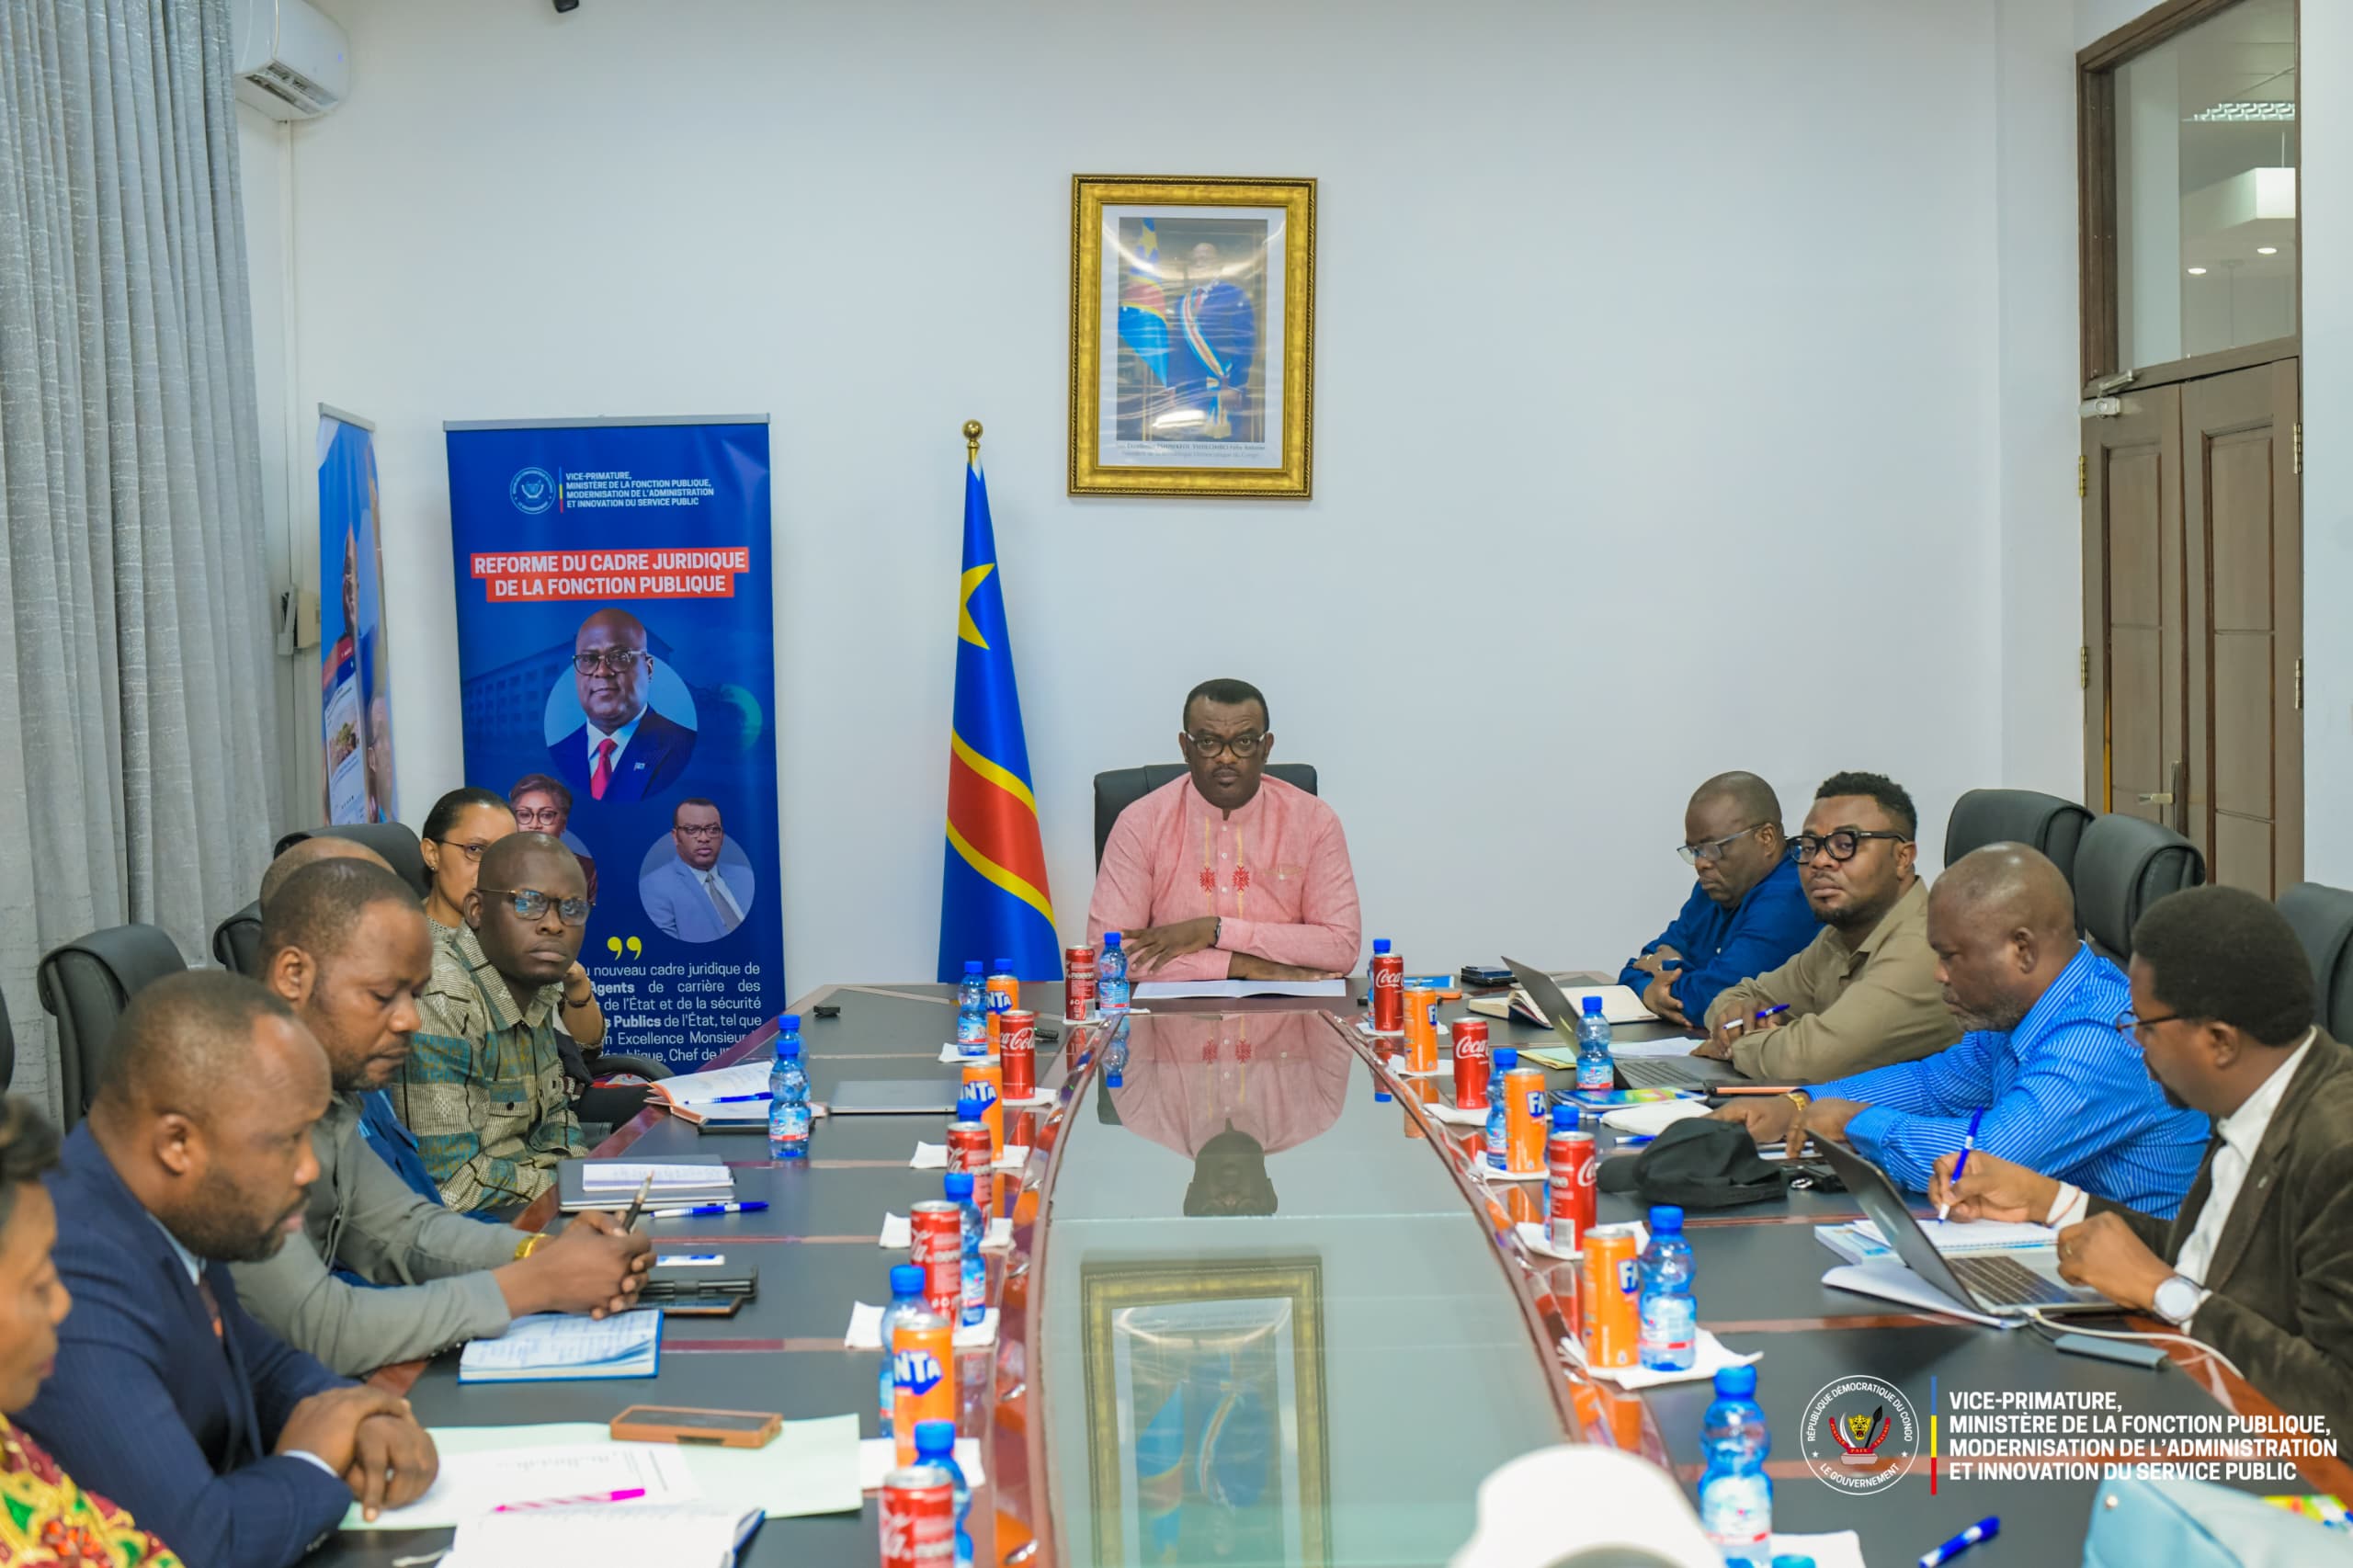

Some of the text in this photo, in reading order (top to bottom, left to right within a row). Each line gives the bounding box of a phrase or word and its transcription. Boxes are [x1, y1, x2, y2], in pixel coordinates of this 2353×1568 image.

[608, 481, 620, 489] DE
[620, 481, 631, 489] LA
[631, 479, 670, 489] FONCTION
[566, 490, 630, 499] MODERNISATION
[631, 489, 642, 498] DE
[566, 496, 699, 508] ET INNOVATION DU SERVICE PUBLIC
[474, 551, 745, 574] REFORME DU CADRE JURIDIQUE
[494, 574, 726, 597] DE LA FONCTION PUBLIQUE
[594, 966, 646, 976] nouveau
[650, 962, 685, 976] cadre
[687, 961, 741, 978] juridique
[744, 961, 761, 975] de
[648, 979, 665, 994] de
[676, 979, 725, 993] carrière
[737, 978, 761, 992] des
[603, 997, 620, 1011] de
[623, 995, 656, 1011] l'État
[659, 998, 673, 1010] et
[676, 995, 692, 1010] de
[696, 995, 707, 1009] la
[710, 995, 762, 1009] sécurité
[613, 1015, 662, 1028] Publics
[664, 1014, 680, 1028] de
[720, 1013, 737, 1027] tel
[738, 1017, 762, 1028] que
[618, 1031, 685, 1045] Excellence
[668, 1048, 699, 1062] Chef
[700, 1047, 717, 1062] de
